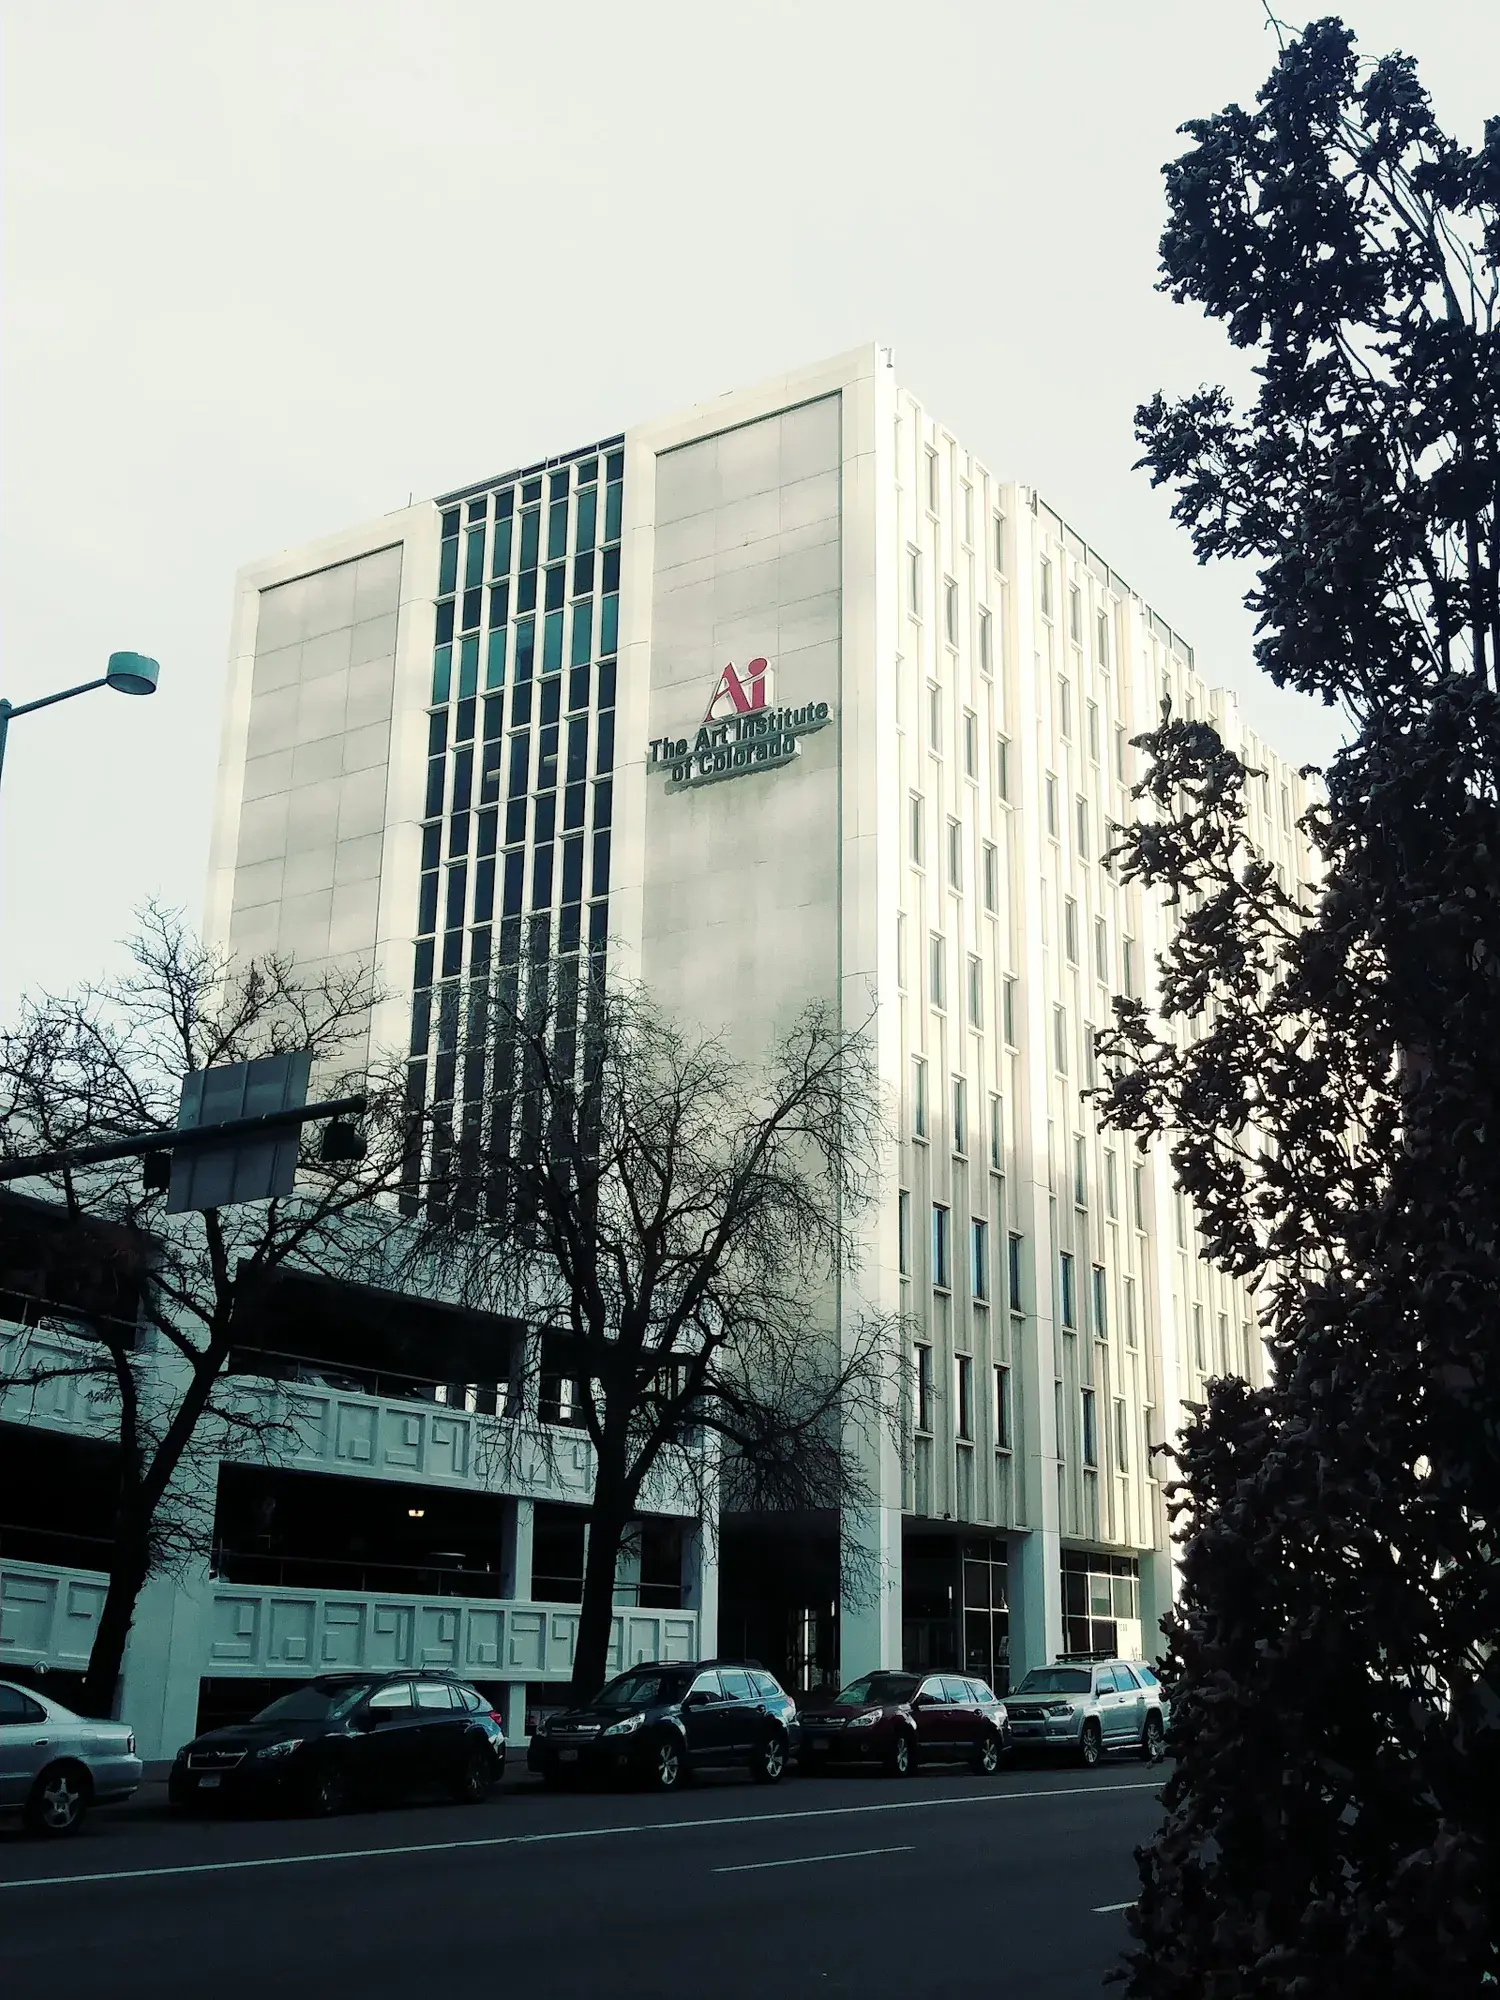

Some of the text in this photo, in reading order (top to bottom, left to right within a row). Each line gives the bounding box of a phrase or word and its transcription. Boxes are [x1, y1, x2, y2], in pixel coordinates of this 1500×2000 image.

[703, 657, 768, 723] Ai
[649, 701, 829, 763] The Art Institute
[671, 734, 796, 783] of Colorado
